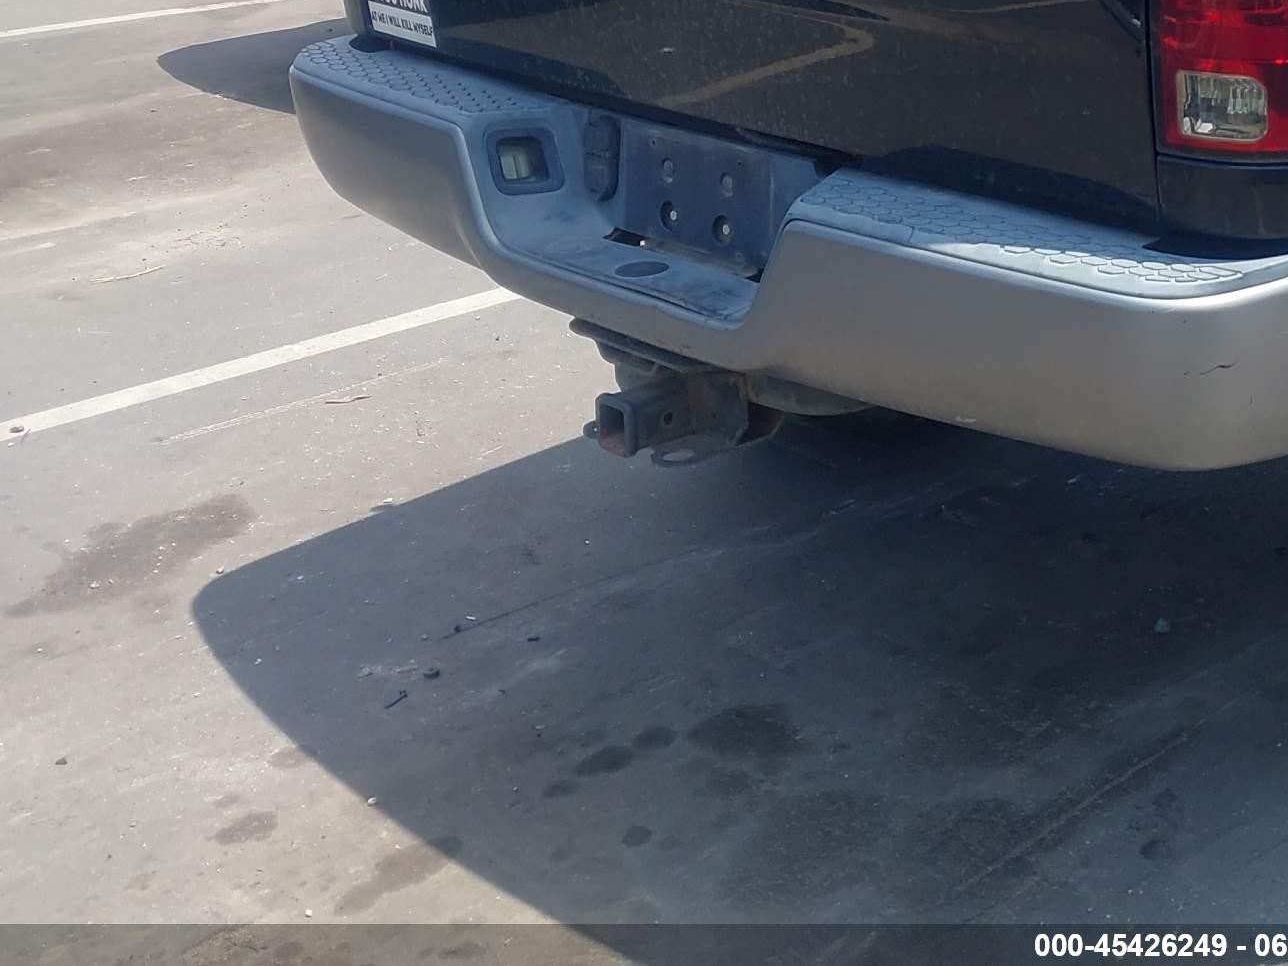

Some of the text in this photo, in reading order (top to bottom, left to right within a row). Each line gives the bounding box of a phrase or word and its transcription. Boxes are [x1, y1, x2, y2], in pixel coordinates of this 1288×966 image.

[372, 11, 377, 21] AT
[377, 12, 385, 23] ME
[388, 15, 401, 28] WILL
[401, 18, 413, 31] KILL
[413, 23, 433, 36] MYSELF
